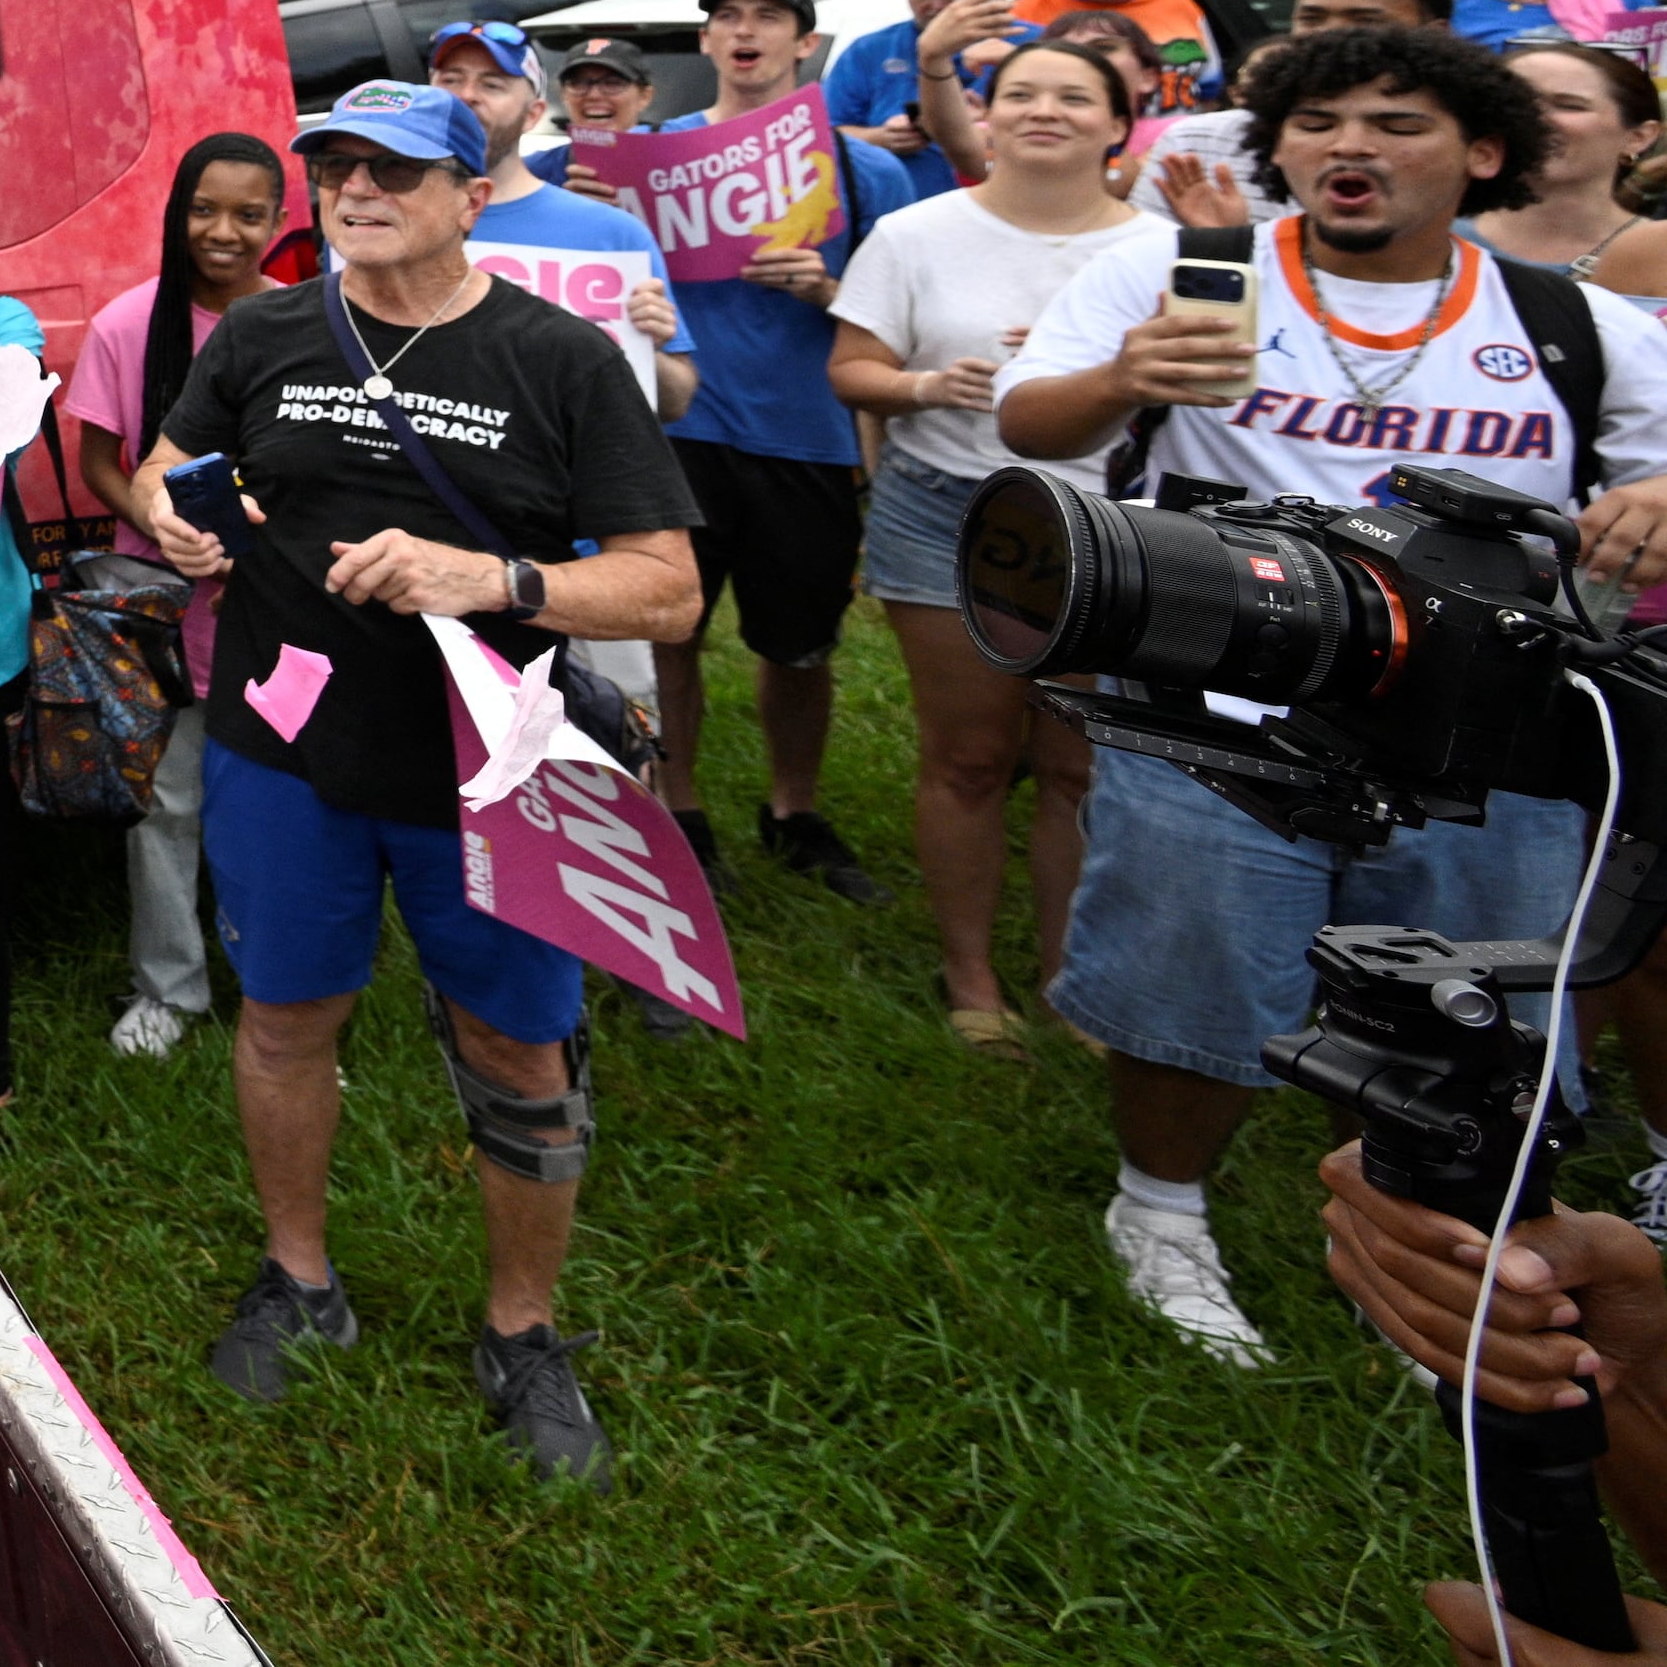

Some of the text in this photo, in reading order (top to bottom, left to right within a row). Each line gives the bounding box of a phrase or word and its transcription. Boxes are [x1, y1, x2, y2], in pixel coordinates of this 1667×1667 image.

[648, 104, 811, 192] GATORS FOR
[615, 128, 819, 252] ANGIE
[276, 402, 507, 449] PRO-DEMCRACY
[281, 385, 510, 427] UNAPOLGETICALLY
[1228, 387, 1554, 460] FLORIDA
[1347, 518, 1399, 543] SONY
